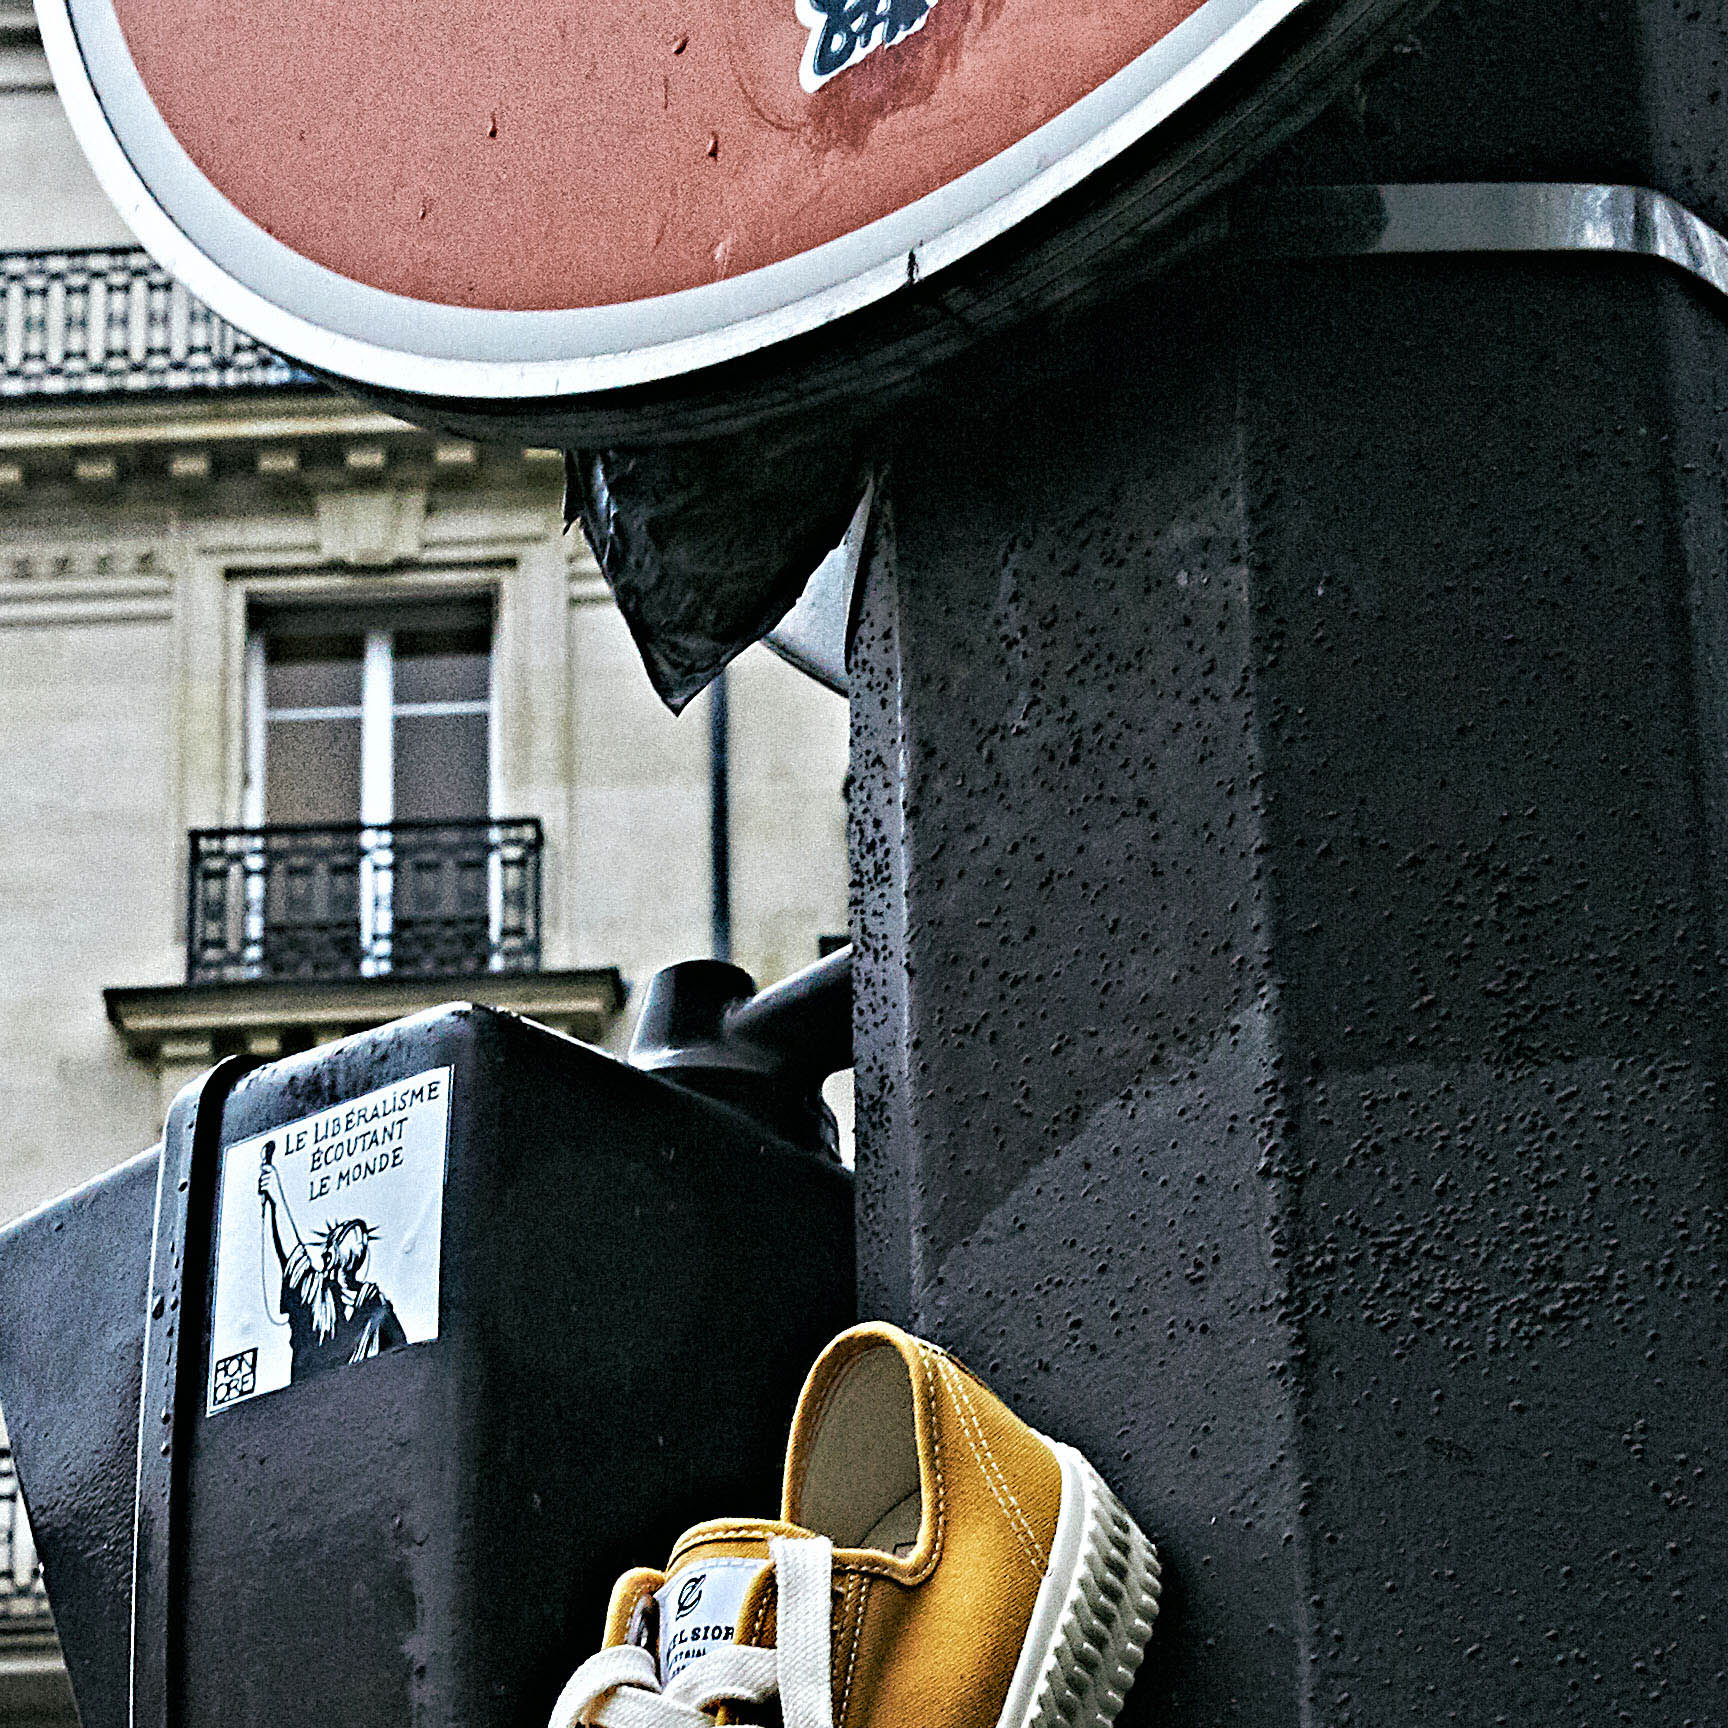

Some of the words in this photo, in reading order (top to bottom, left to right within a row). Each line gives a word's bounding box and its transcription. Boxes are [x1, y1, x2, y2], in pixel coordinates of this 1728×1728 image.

[284, 1131, 308, 1156] LE
[309, 1176, 331, 1202] LE
[336, 1146, 404, 1190] MONDE
